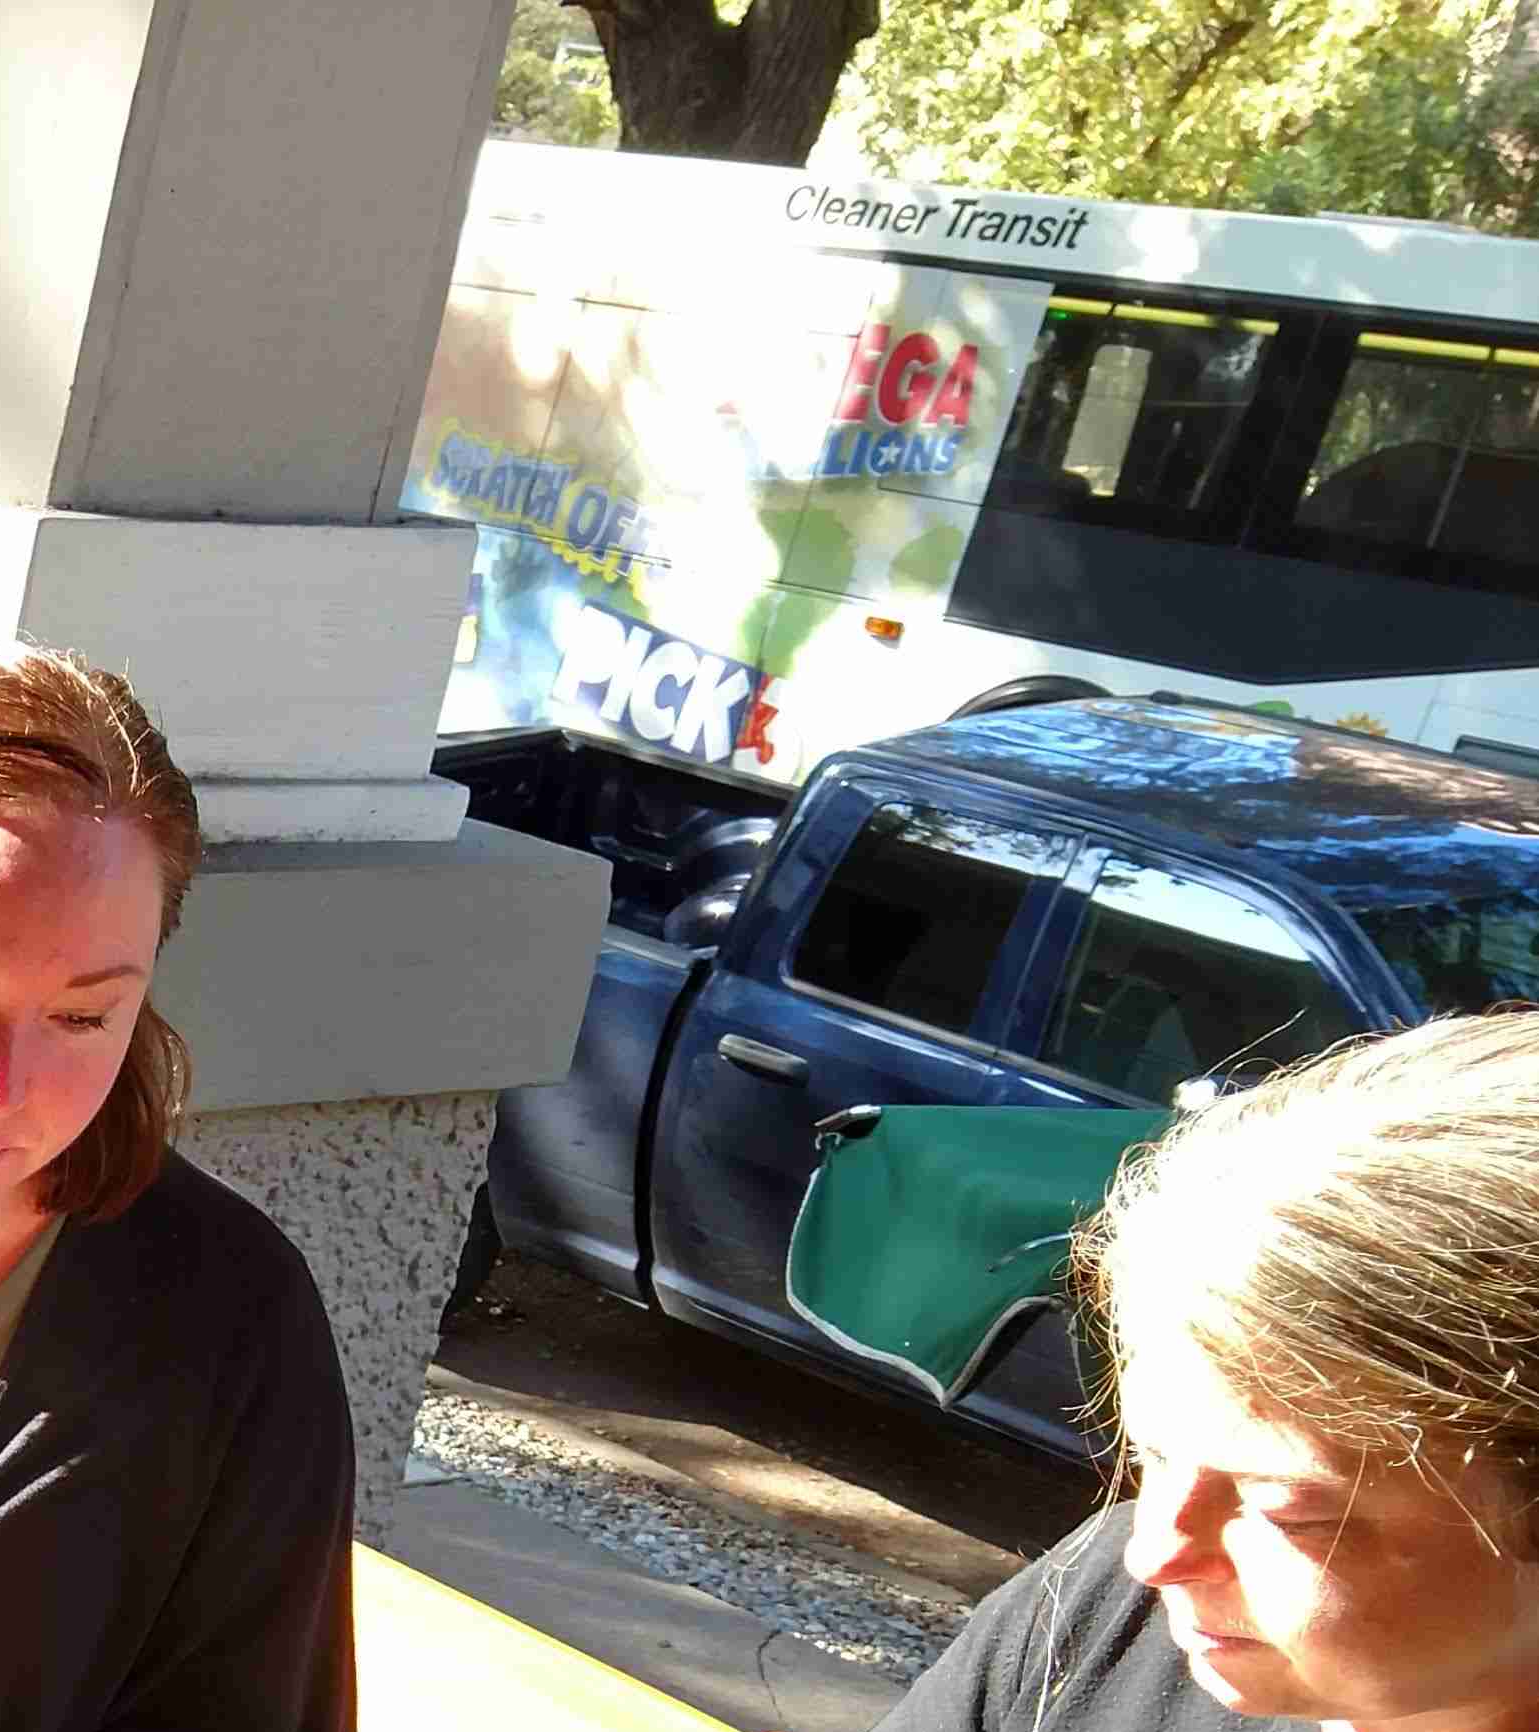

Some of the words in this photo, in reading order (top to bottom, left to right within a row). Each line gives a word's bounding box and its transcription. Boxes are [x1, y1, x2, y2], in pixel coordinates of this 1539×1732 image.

[785, 184, 940, 235] Cleaner
[946, 198, 1089, 249] Transit
[831, 322, 979, 426] EGA
[550, 604, 750, 764] PICK
